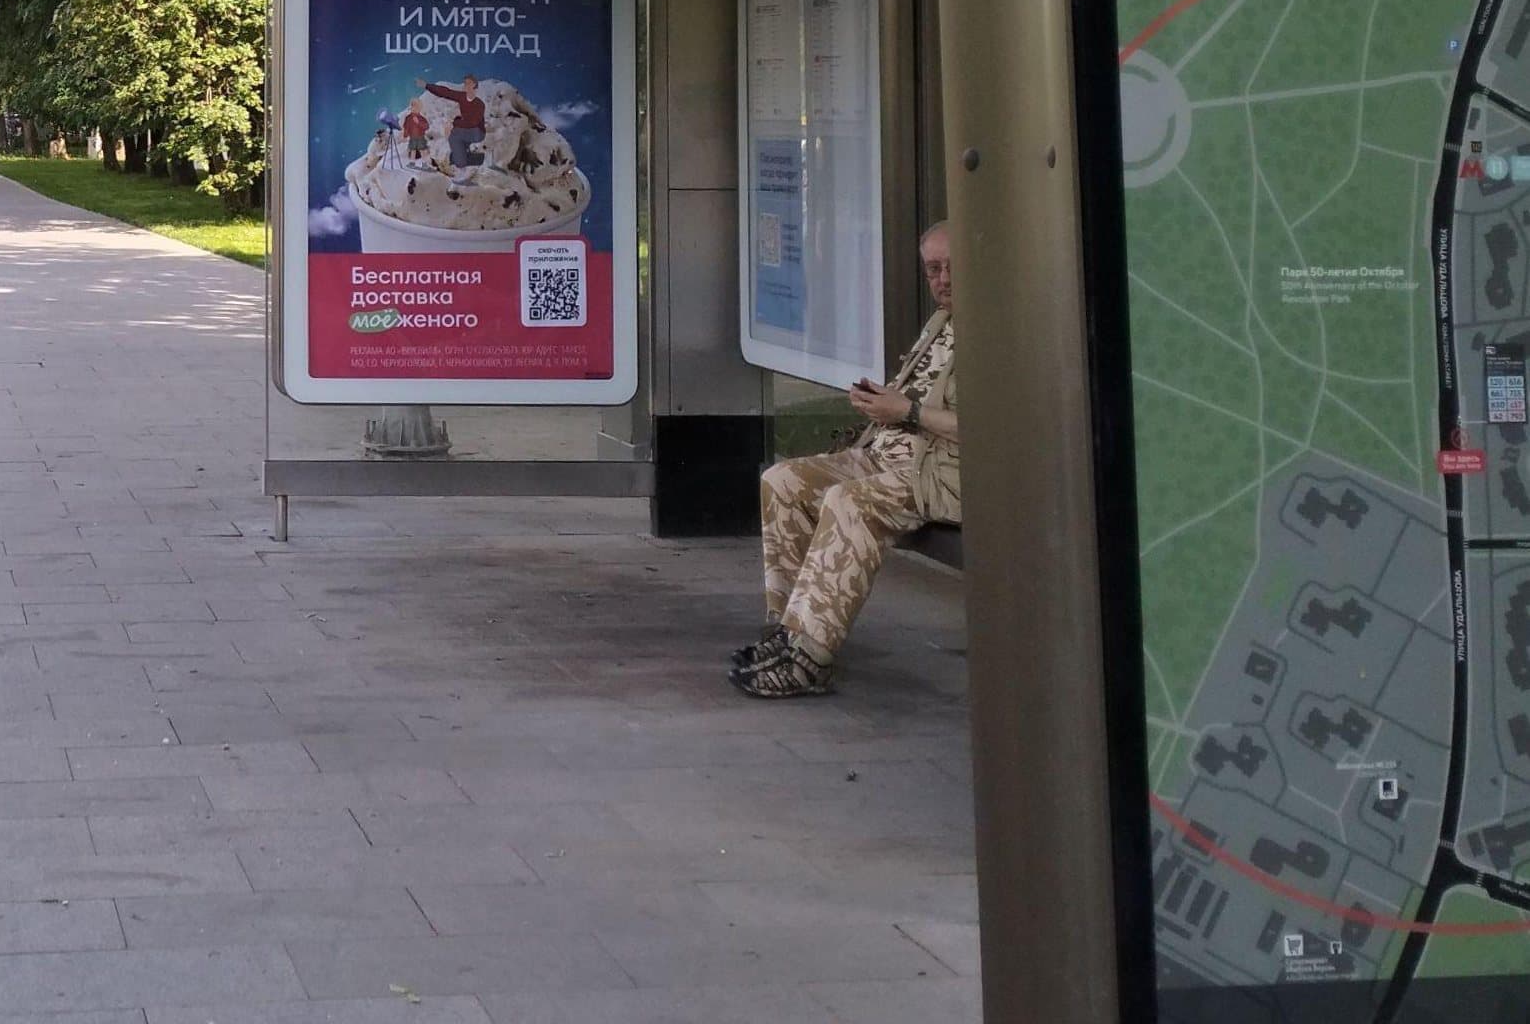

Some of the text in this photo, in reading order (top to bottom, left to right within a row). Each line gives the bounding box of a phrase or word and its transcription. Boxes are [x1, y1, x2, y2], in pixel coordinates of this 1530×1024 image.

[399, 7, 423, 27] И
[385, 33, 542, 58] ШОКОЛАД
[528, 256, 579, 264] приложение
[351, 266, 482, 285] Бесплатная
[1359, 266, 1404, 278] Октября
[351, 291, 453, 307] доставка
